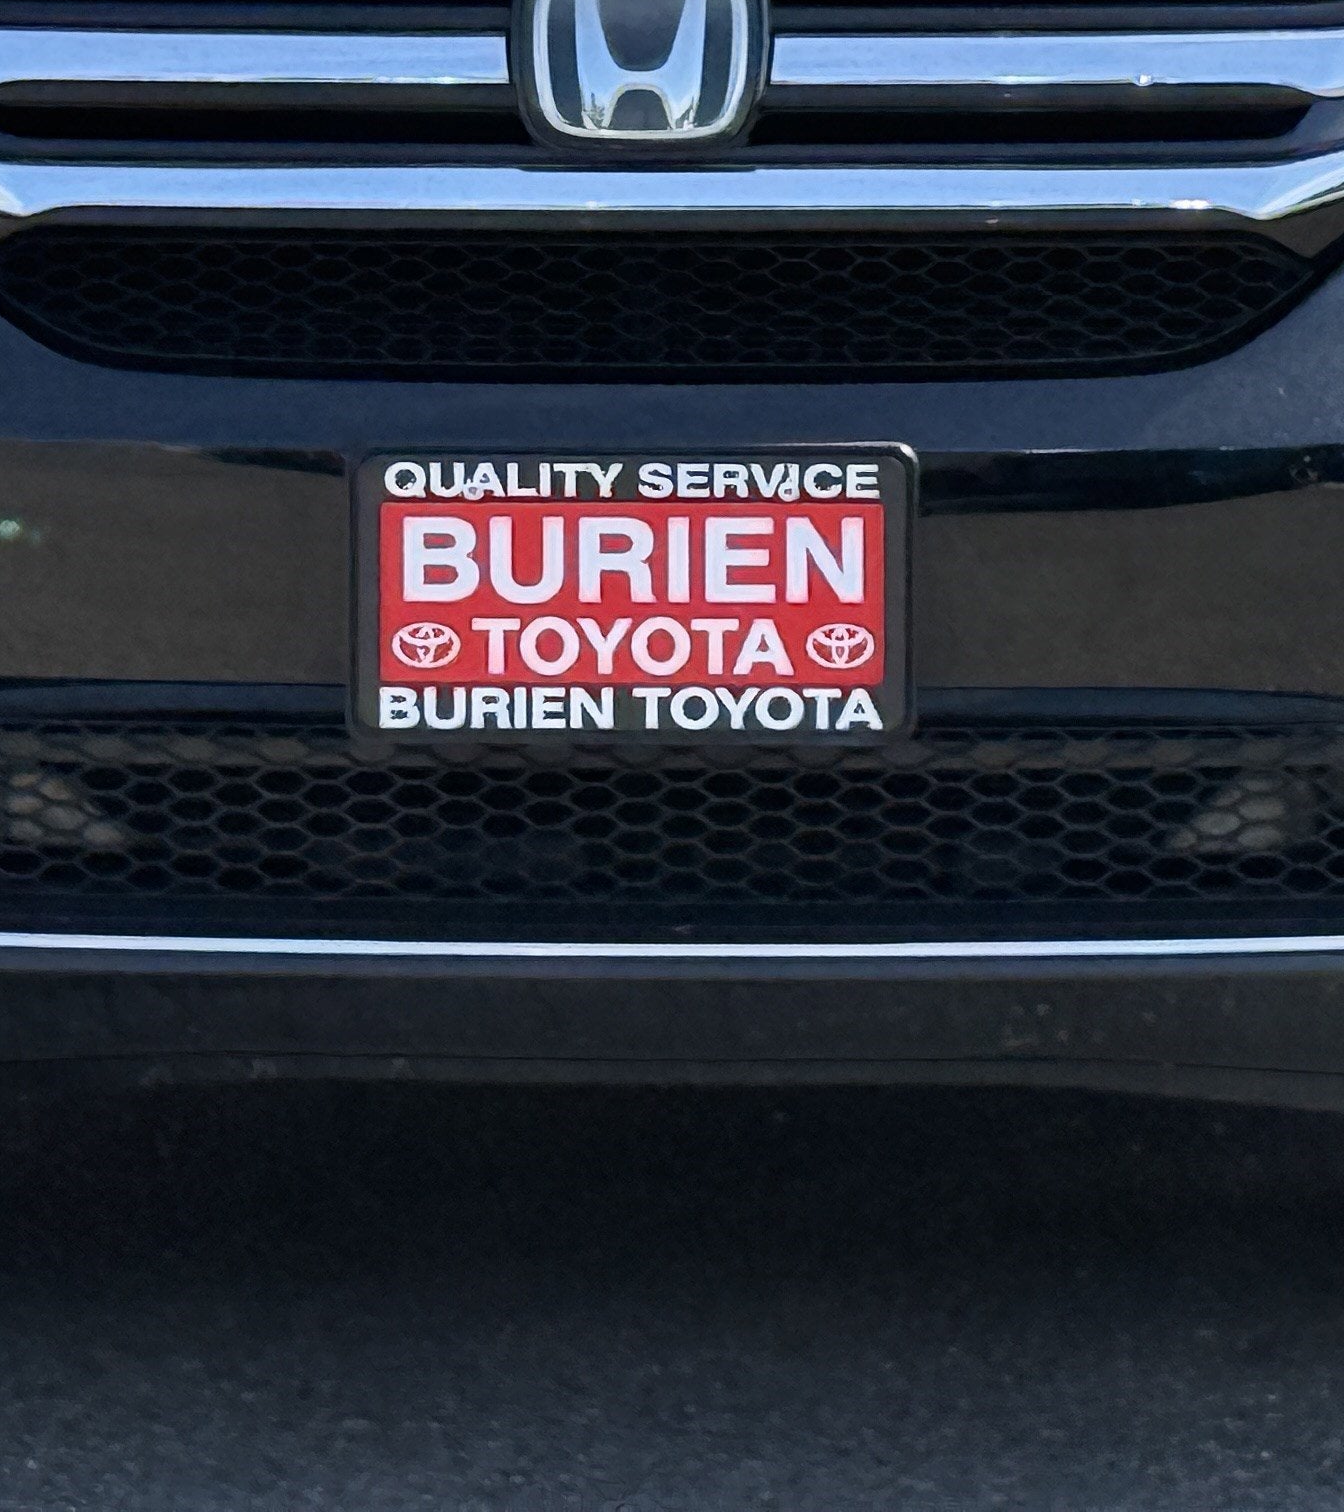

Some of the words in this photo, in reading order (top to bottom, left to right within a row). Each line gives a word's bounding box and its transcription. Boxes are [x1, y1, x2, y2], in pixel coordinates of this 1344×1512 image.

[383, 461, 623, 499] QUALITY
[637, 463, 881, 500] SERVICE
[401, 515, 865, 604] BURIEN
[472, 617, 794, 677] TOYOTA
[378, 686, 615, 730] BURIEN
[632, 686, 884, 731] TOYOTA
